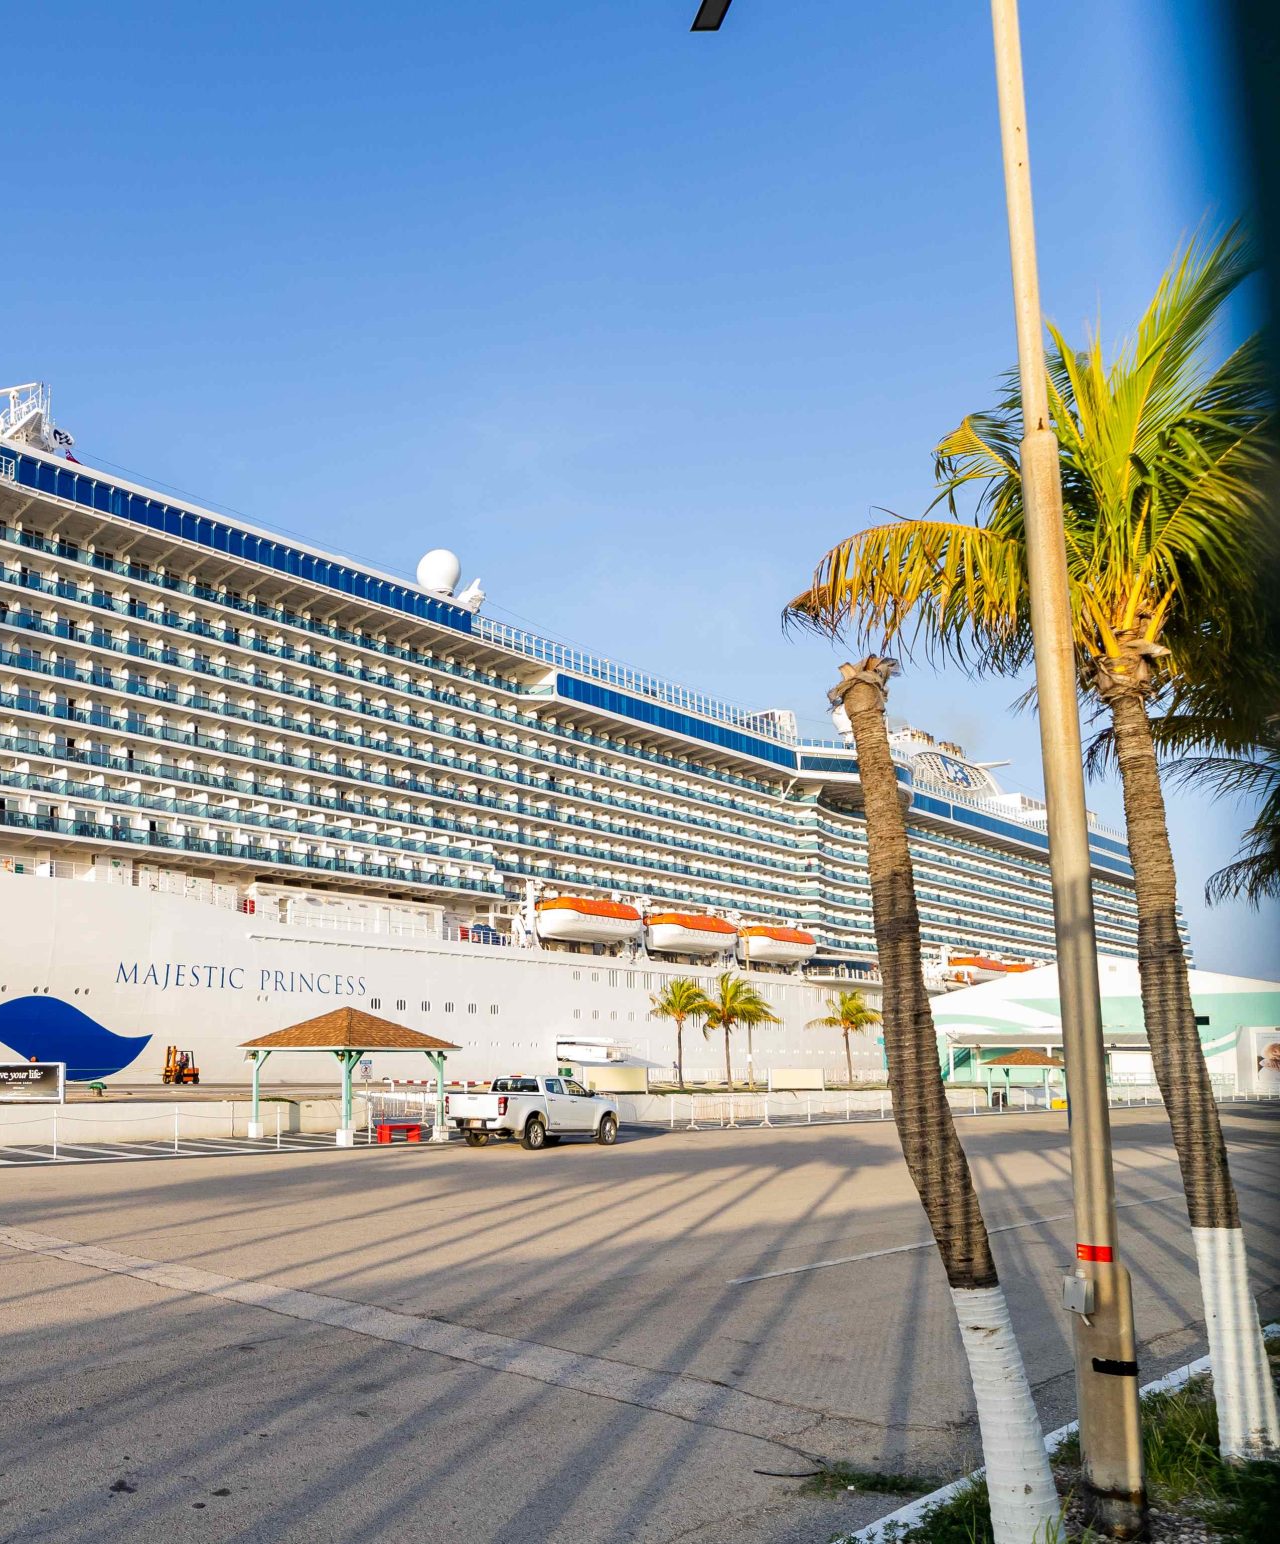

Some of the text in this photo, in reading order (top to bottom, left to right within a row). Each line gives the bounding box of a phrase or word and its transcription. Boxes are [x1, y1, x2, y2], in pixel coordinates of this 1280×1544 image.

[115, 961, 366, 996] MAJESTIC PRINCESS
[9, 1072, 28, 1081] your
